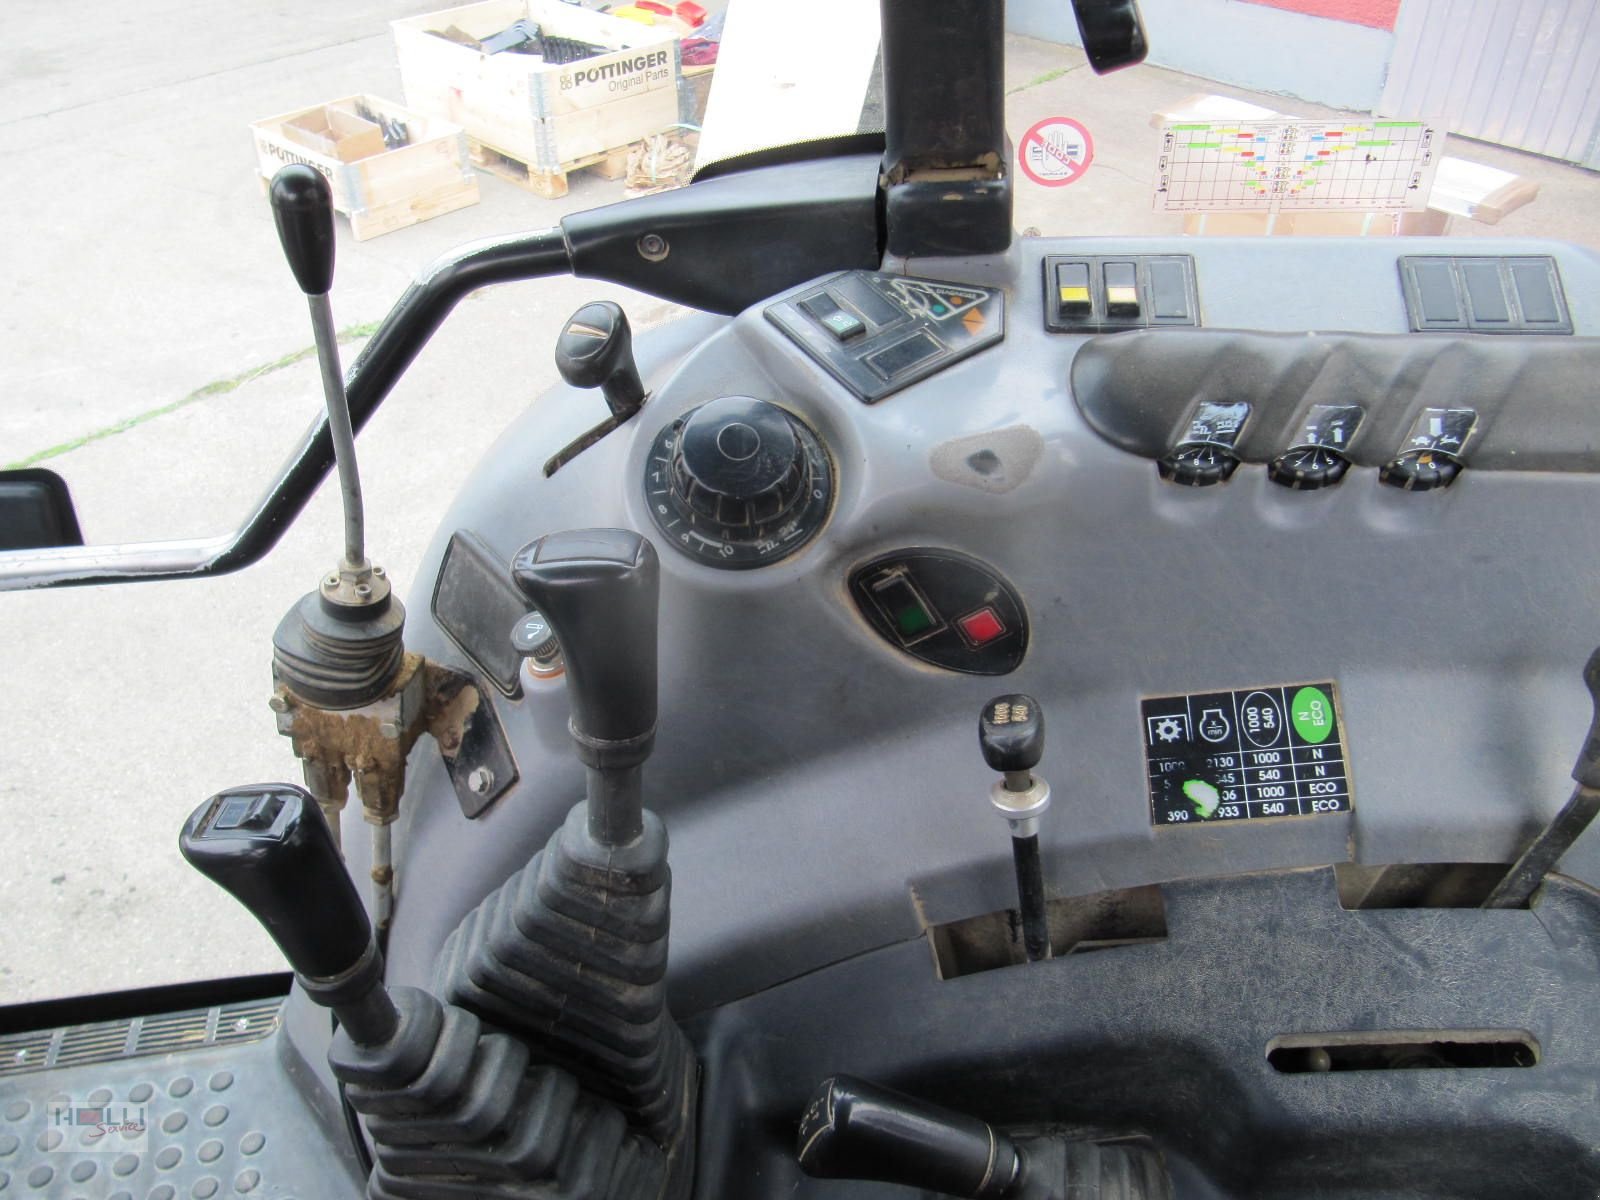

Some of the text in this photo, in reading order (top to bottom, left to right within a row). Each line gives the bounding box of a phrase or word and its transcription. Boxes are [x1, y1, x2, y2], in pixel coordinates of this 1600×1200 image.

[609, 68, 669, 92] Original Parts
[1311, 462, 1319, 470] 6
[658, 504, 668, 514] 8
[681, 533, 690, 543] 9
[718, 546, 735, 558] 10
[1247, 706, 1260, 732] 1000
[1263, 707, 1275, 728] 540
[1299, 712, 1310, 721] N
[1310, 700, 1325, 726] ECO
[1252, 752, 1280, 764] 1000
[1312, 749, 1323, 759] N
[1258, 770, 1280, 781] 540
[1315, 766, 1325, 776] N
[1257, 786, 1285, 798] 1000
[1309, 782, 1337, 794] ECO
[1167, 800, 1340, 822] 390 933 540 ECO
